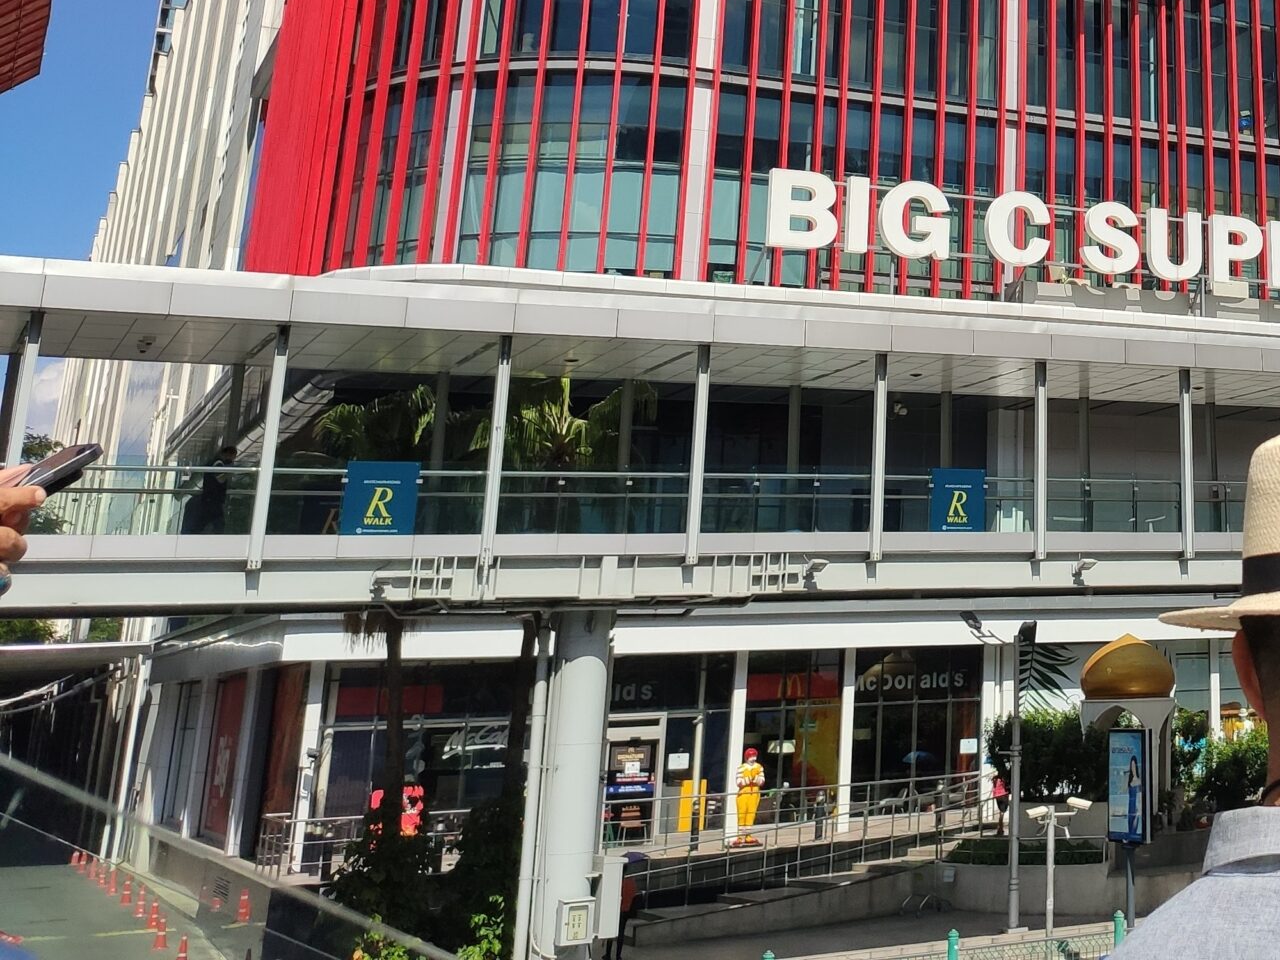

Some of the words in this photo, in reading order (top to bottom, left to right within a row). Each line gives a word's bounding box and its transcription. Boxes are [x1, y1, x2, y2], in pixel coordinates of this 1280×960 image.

[765, 168, 951, 261] BIG
[984, 190, 1051, 267] C
[366, 487, 393, 517] R
[948, 490, 967, 517] R
[364, 517, 393, 526] WALK
[947, 516, 968, 524] WALK
